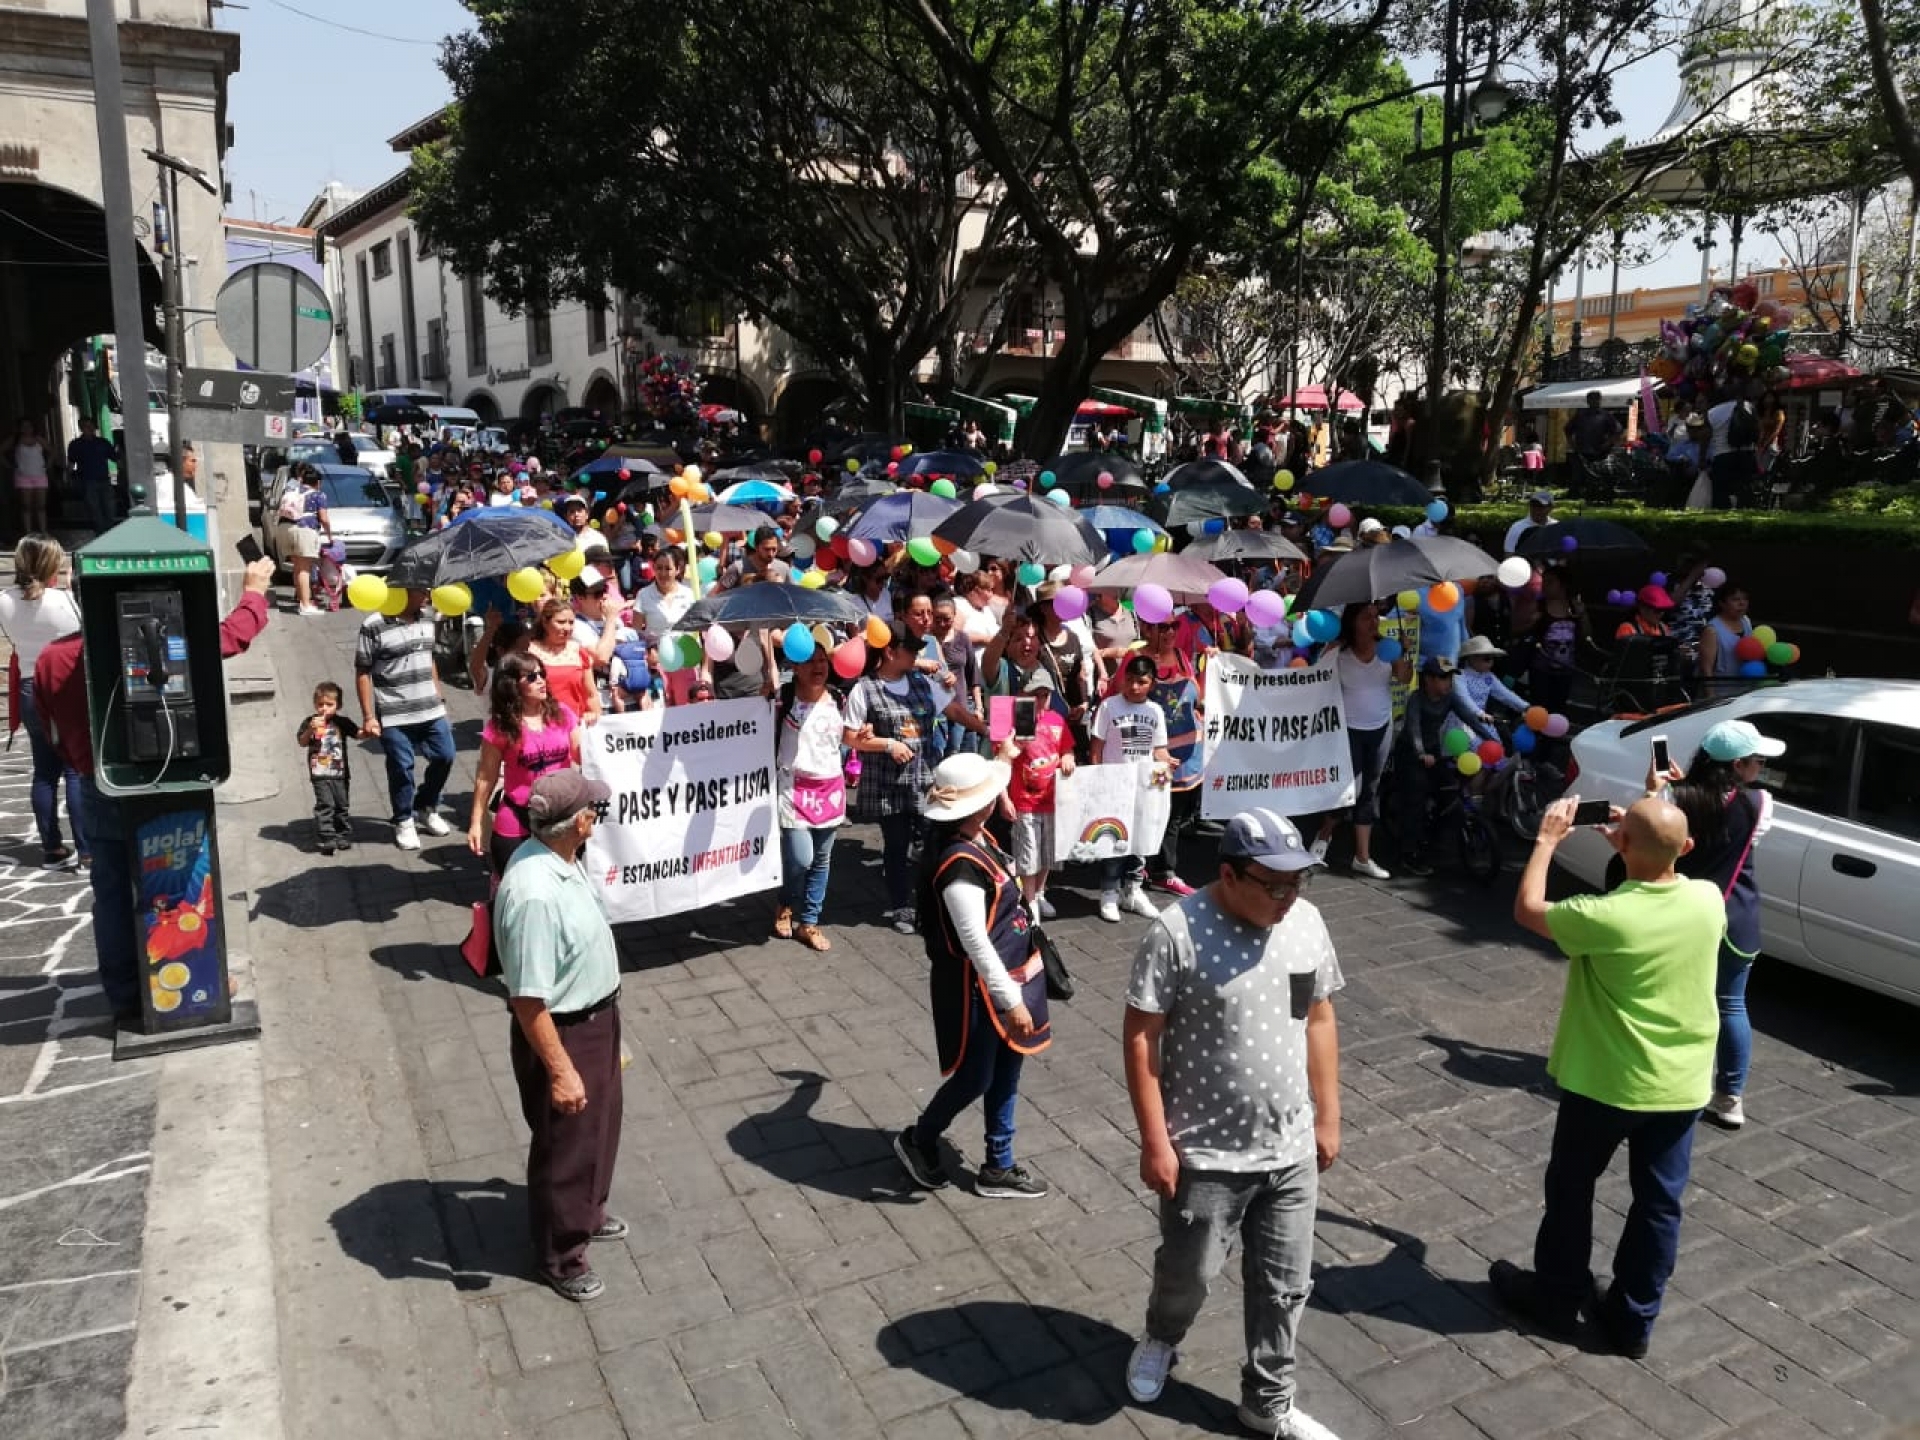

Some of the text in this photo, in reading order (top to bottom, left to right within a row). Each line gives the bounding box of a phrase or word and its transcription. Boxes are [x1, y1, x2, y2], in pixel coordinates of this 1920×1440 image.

[605, 719, 757, 753] Señor presidente:
[1223, 715, 1255, 741] PASE
[1258, 715, 1267, 742] Y
[1271, 715, 1308, 742] PASE
[618, 786, 661, 825] PASE
[667, 782, 679, 816] Y
[685, 777, 728, 814] PASE
[734, 766, 771, 805] LISTA
[1212, 765, 1339, 792] # ESTANCIAS INFANTILES SI
[142, 818, 205, 857] Hola!
[606, 836, 764, 886] # ESTANCIAS INFANTILES SI
